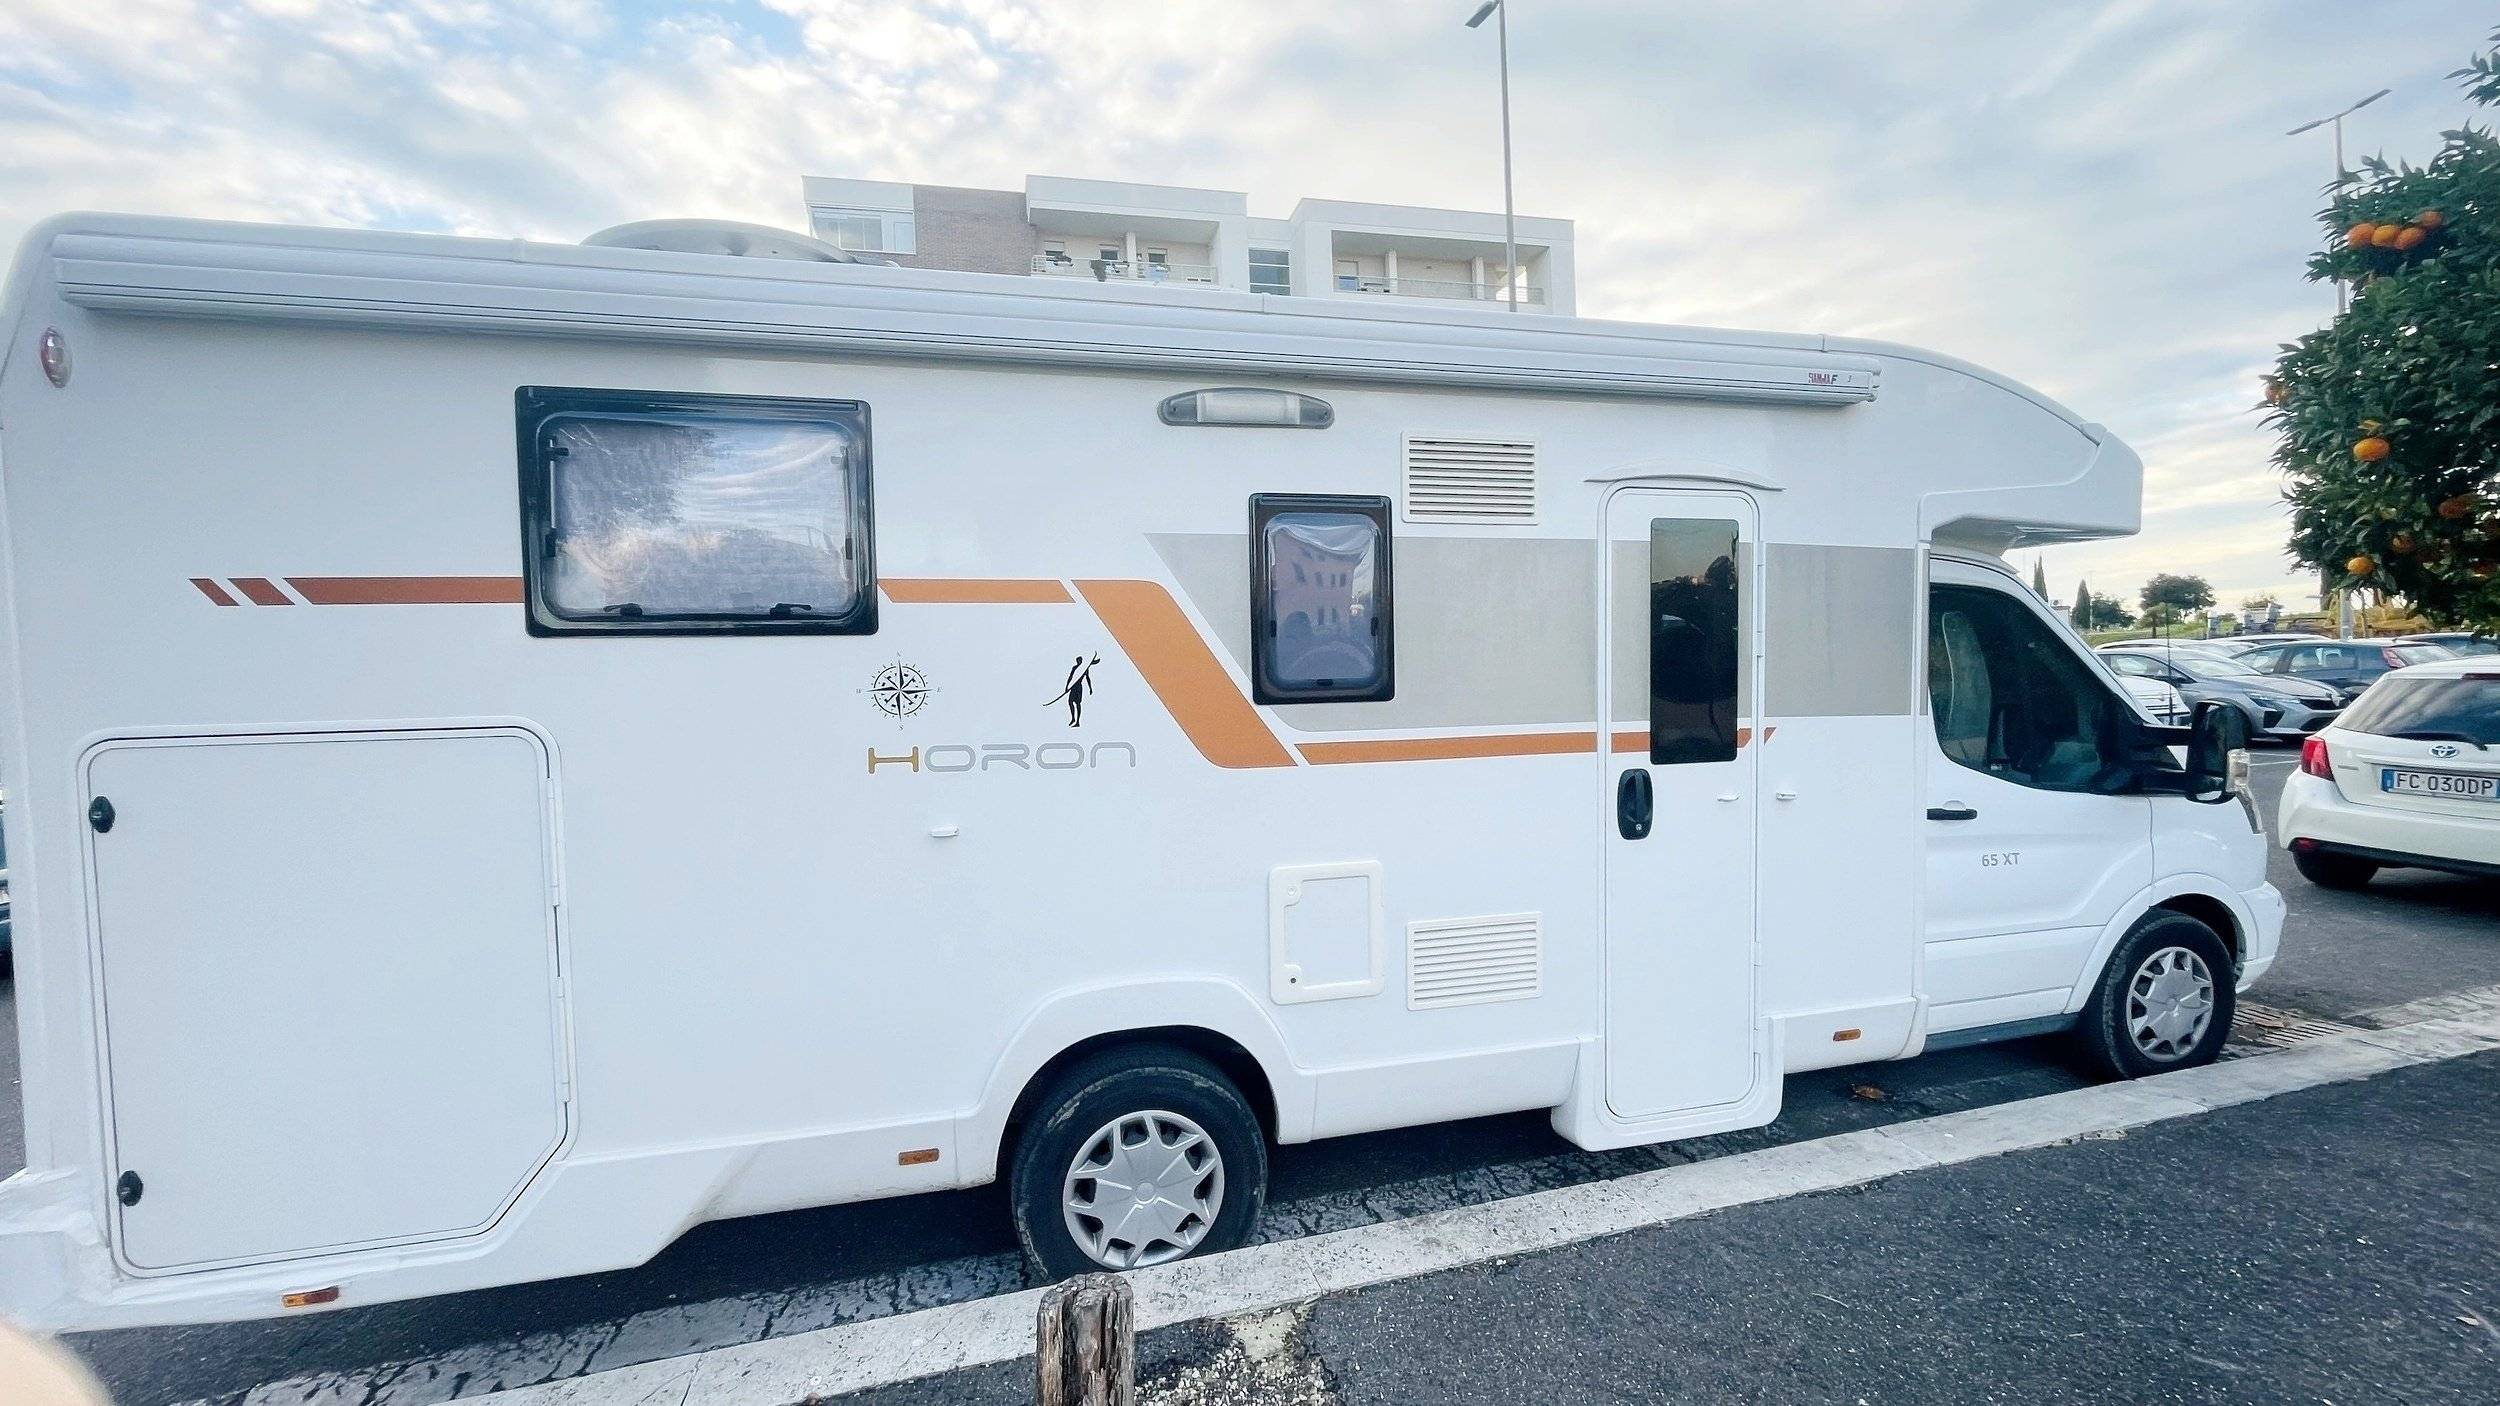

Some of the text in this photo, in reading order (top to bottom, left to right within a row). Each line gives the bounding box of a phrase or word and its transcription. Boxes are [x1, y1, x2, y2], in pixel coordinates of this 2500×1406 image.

[867, 741, 1137, 775] HORON
[2396, 772, 2420, 790] FC
[2427, 775, 2494, 796] 030DP
[1982, 852, 2021, 867] 65 XT
